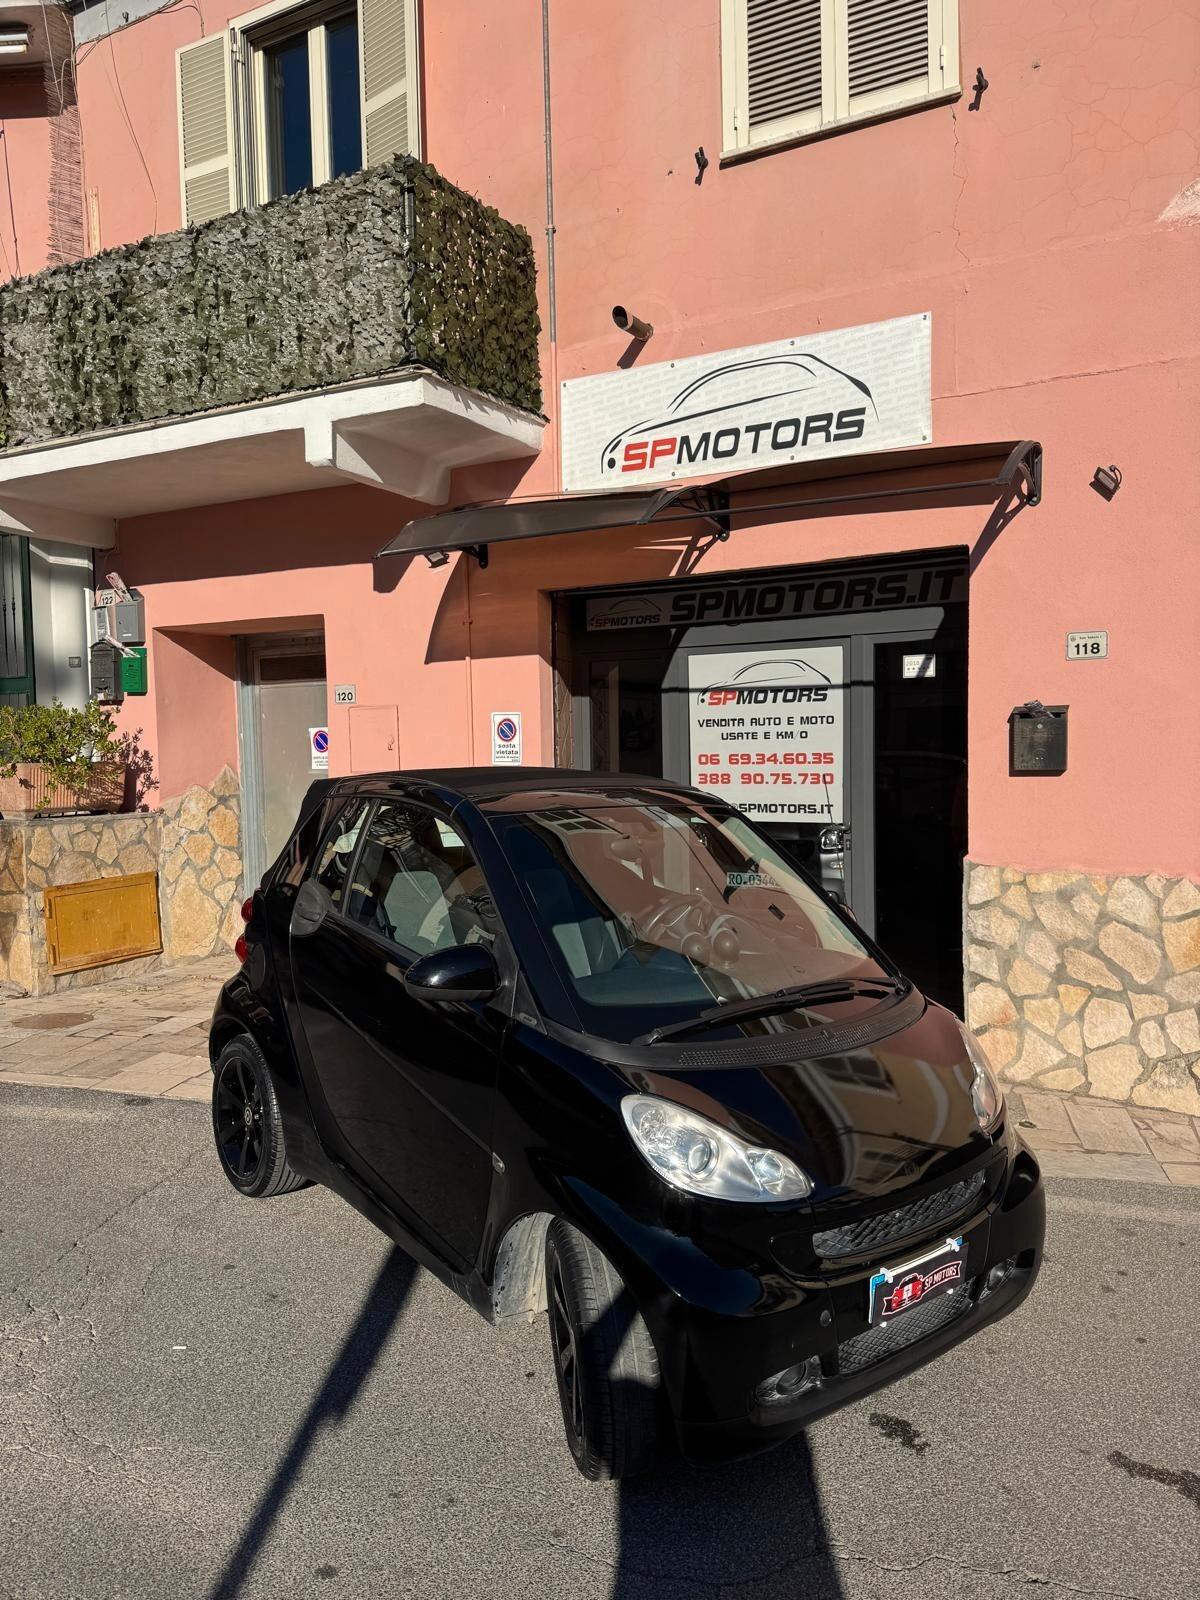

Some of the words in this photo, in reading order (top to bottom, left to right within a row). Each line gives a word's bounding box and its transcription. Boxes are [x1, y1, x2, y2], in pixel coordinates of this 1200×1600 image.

[621, 407, 866, 473] SPMOTORS
[669, 568, 965, 623] SPMOTORS.IT
[594, 613, 661, 628] SPMOTORS
[1074, 642, 1100, 655] 118
[337, 692, 353, 701] 120
[707, 687, 828, 706] SPMOTORS
[697, 718, 745, 728] VENDITA
[750, 717, 782, 727] AUTO
[787, 716, 794, 726] E
[800, 715, 835, 726] MOTO
[721, 732, 758, 741] USATE
[763, 732, 771, 740] E
[698, 754, 720, 765] 06
[728, 752, 834, 765] 69.34.60.35
[698, 773, 731, 785] 388
[740, 773, 834, 785] 90.75.730
[924, 1276, 933, 1290] SP
[933, 1265, 958, 1284] MOTORS
